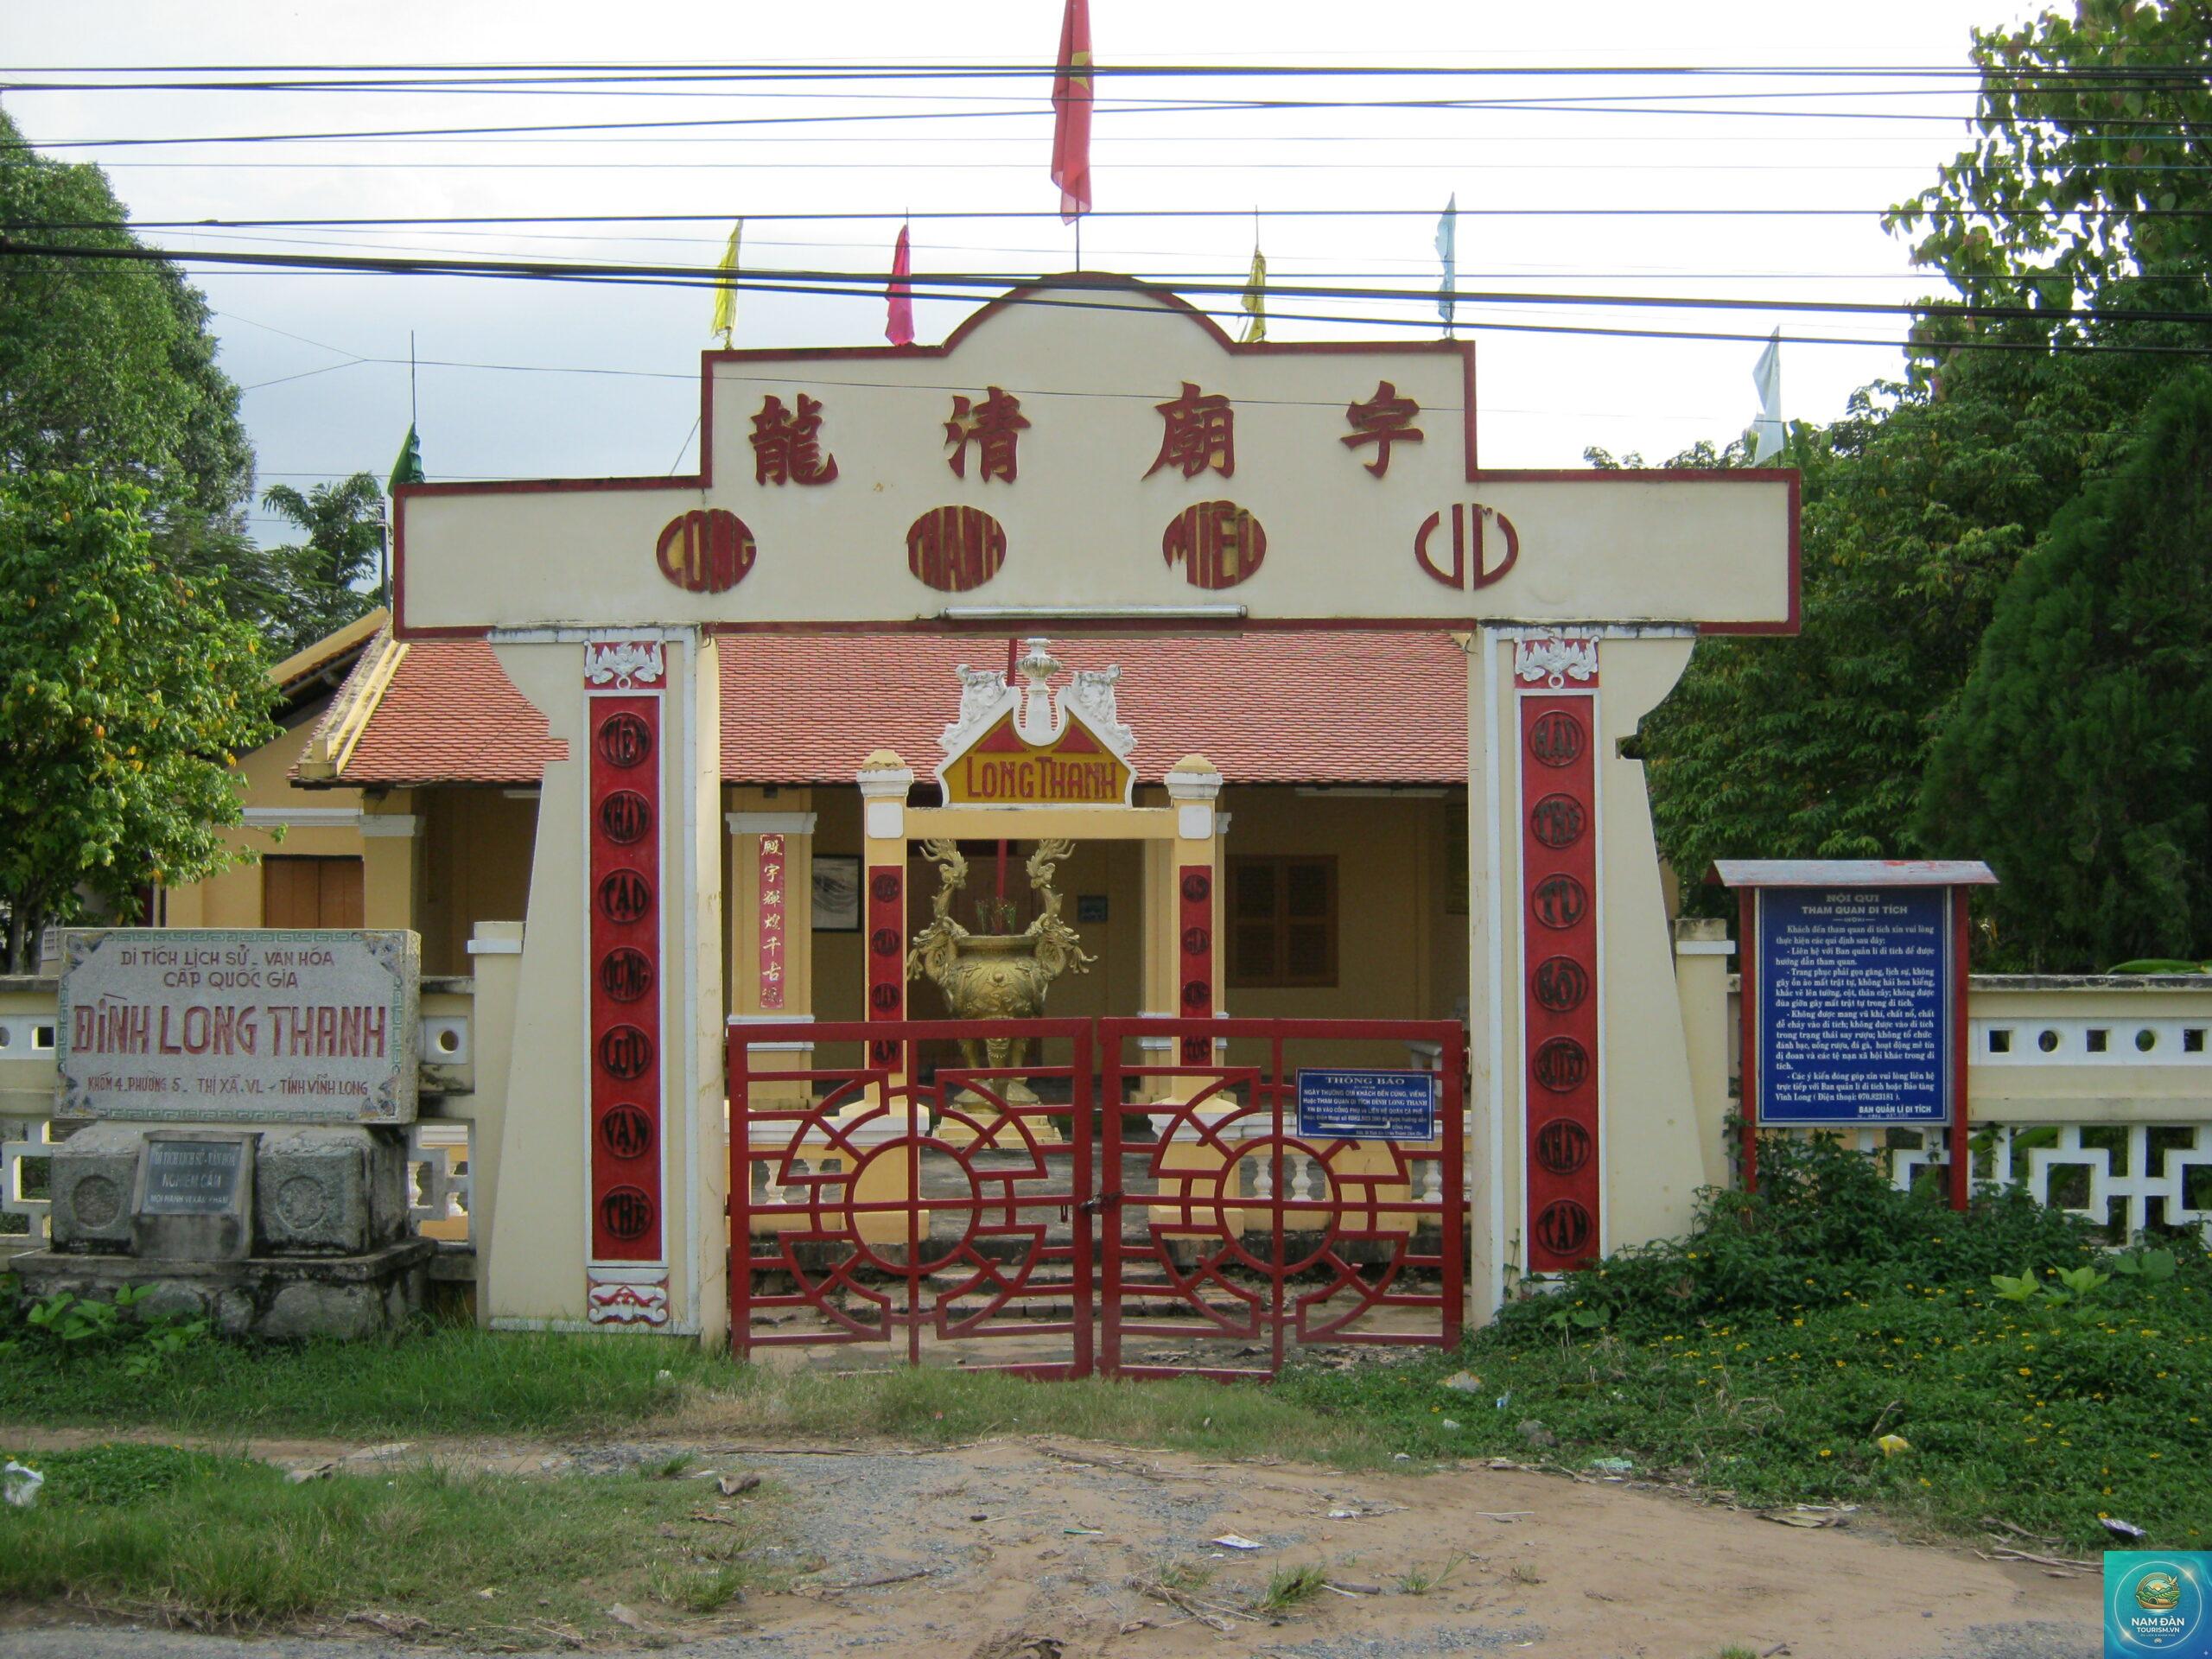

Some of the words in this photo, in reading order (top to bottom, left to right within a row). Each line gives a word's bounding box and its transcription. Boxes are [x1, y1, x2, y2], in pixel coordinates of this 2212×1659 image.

[966, 756, 1035, 798] LONG
[1035, 756, 1118, 799] THANH
[1827, 893, 1852, 903] NỘI
[1801, 906, 1832, 914] THAM
[1882, 905, 1908, 914] TÍCH
[141, 946, 178, 965] TÍCH
[183, 949, 219, 968] LỊCH
[299, 946, 334, 966] HÓA
[208, 967, 260, 991] QUỐC
[71, 993, 151, 1055] ĐÌNH
[159, 1005, 257, 1056] LONG
[267, 1006, 386, 1058] THANH
[339, 1081, 368, 1096] LONG
[1875, 1104, 1896, 1113] QUẢN
[1897, 1104, 1904, 1113] LÍ
[1915, 1104, 1932, 1113] TÍCH
